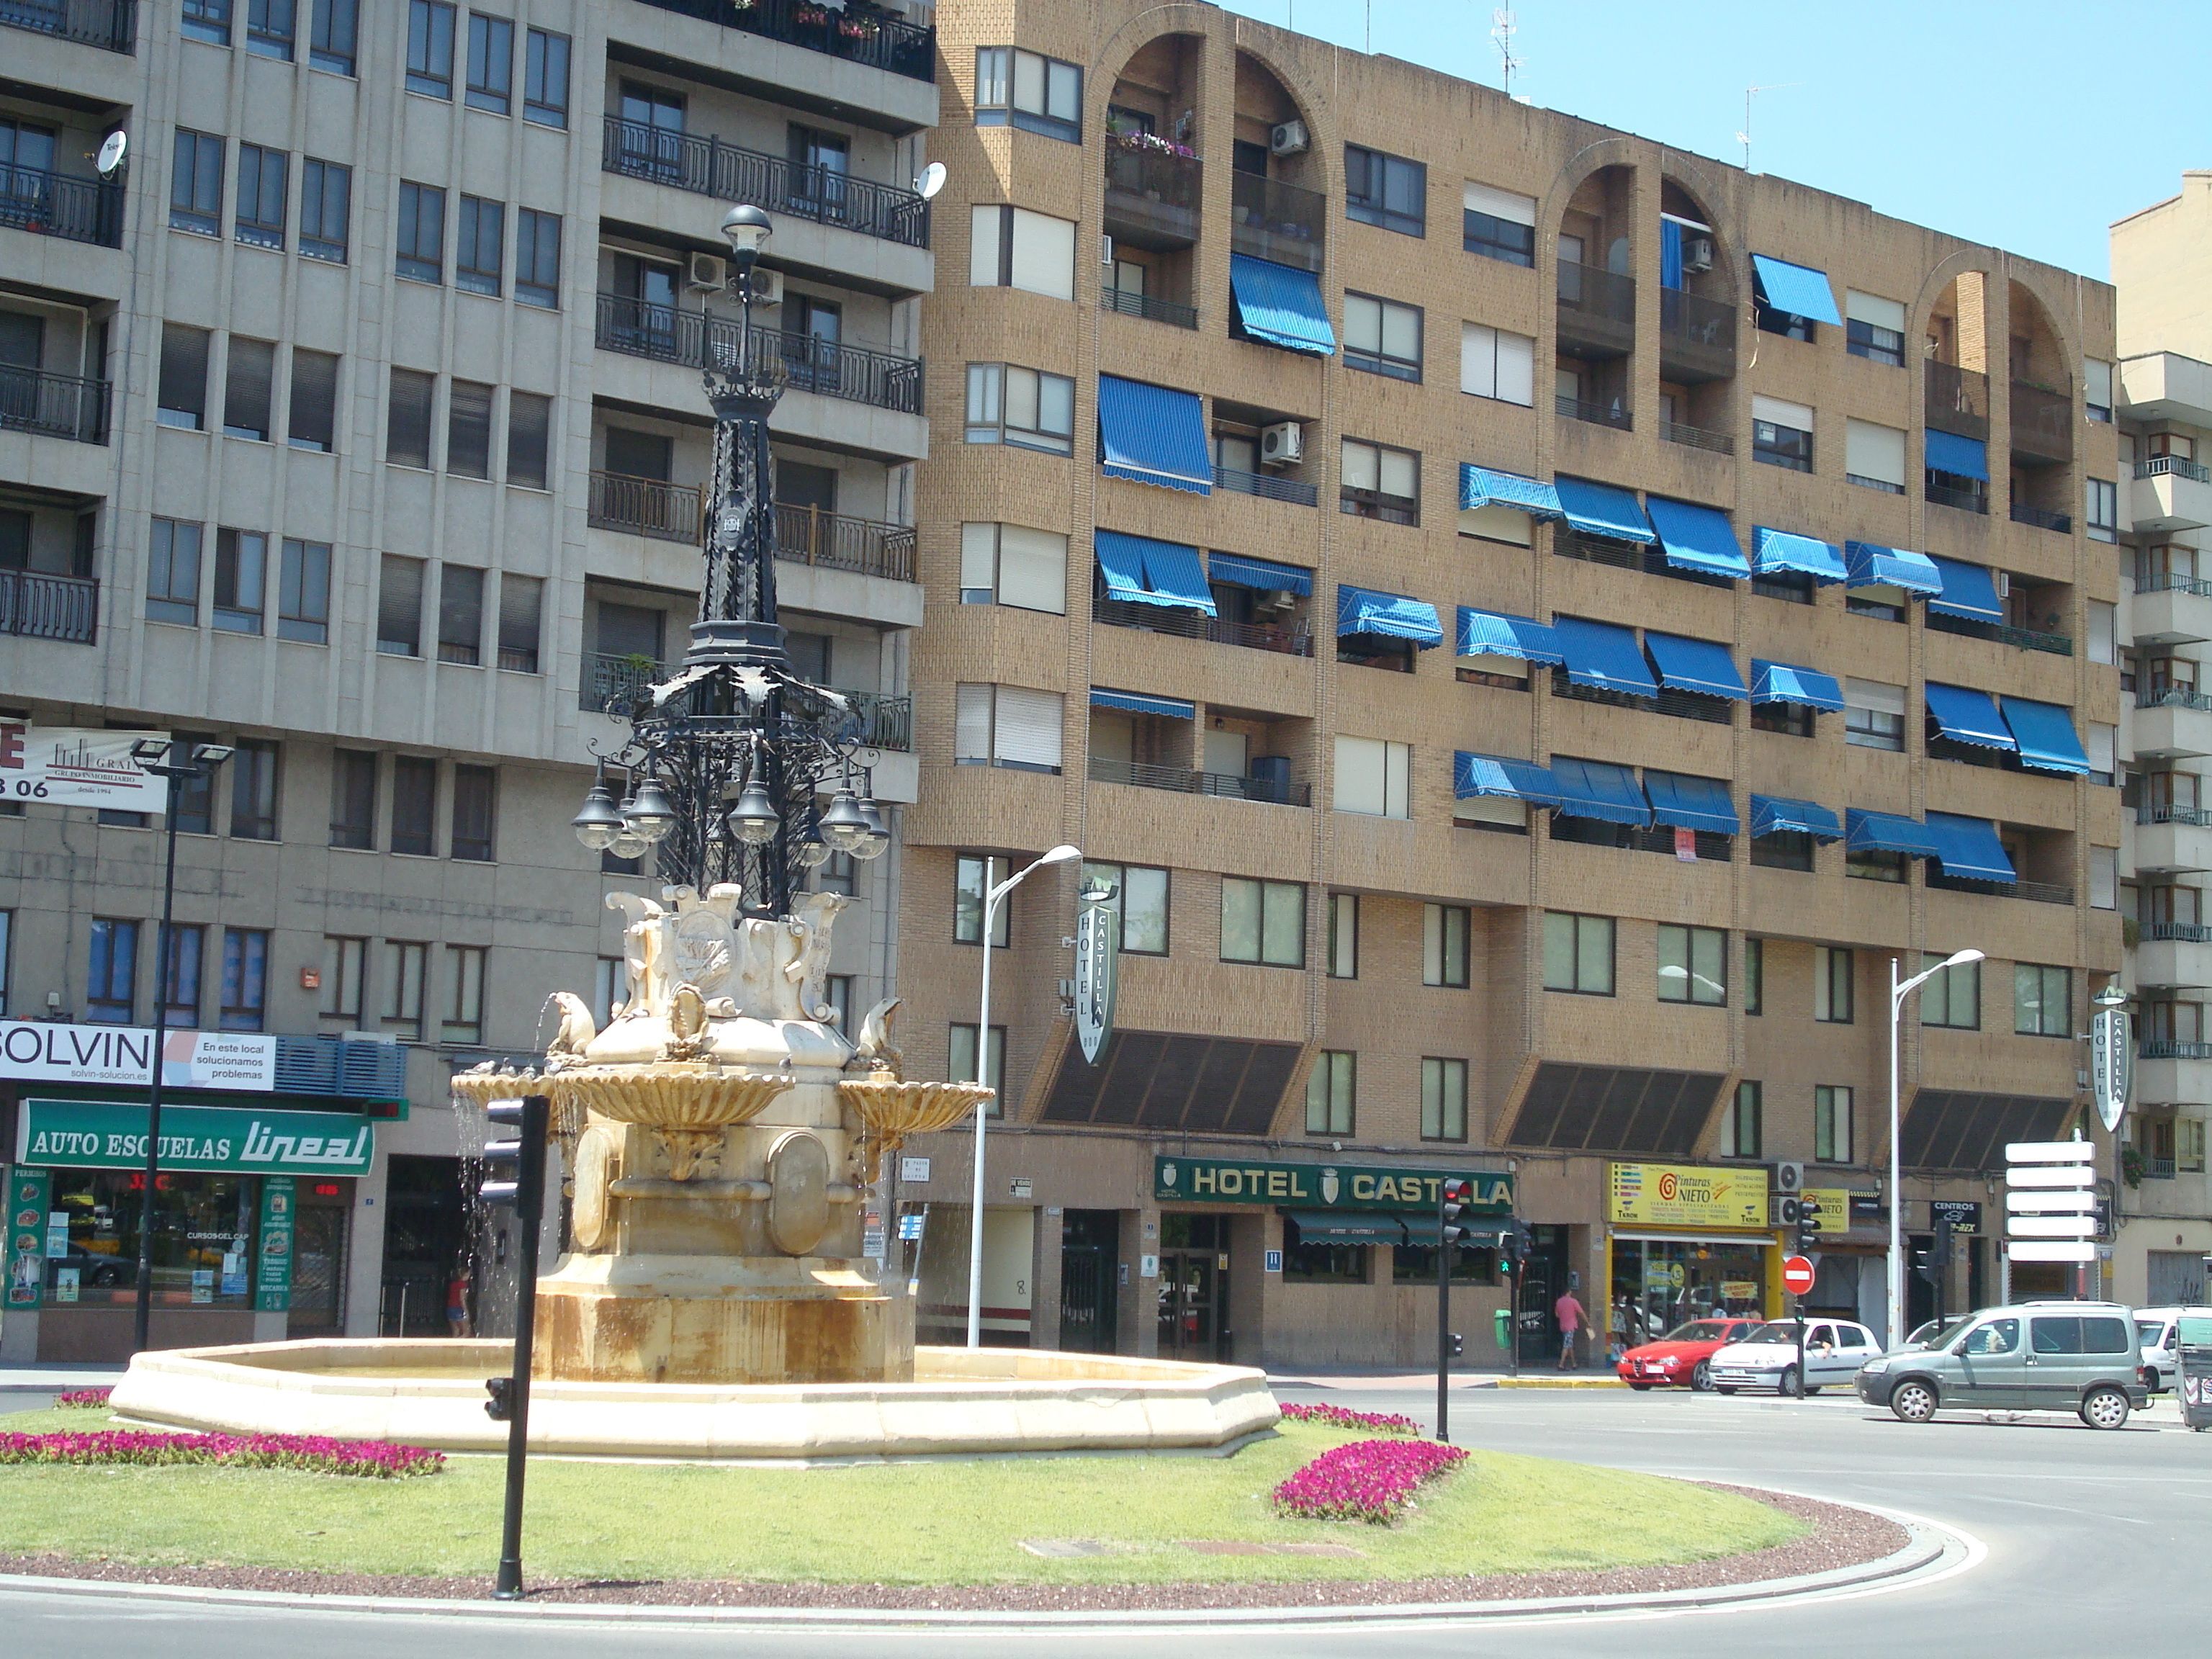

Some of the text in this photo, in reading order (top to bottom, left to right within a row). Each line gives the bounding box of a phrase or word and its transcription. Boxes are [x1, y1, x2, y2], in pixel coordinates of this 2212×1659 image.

[81, 772, 135, 783] INMOBILIARIO
[16, 780, 48, 798] 06
[1081, 917, 1089, 1015] HOTEL
[1095, 916, 1106, 1015] CASTILLA
[0, 1027, 149, 1069] OLVIN
[203, 1043, 264, 1054] En este local
[197, 1056, 264, 1066] solucionamos
[2096, 1019, 2105, 1094] HOTEL
[71, 1069, 148, 1081] solvin-solucion.es
[212, 1069, 263, 1079] problemas
[32, 1131, 99, 1156] AUTO
[239, 1121, 368, 1165] lineal
[1194, 1167, 1513, 1205] HOTEL CASTLA
[1675, 1174, 1711, 1188] Pinturas
[1678, 1189, 1711, 1202] NIETO
[1935, 1202, 1974, 1211] CENTROS
